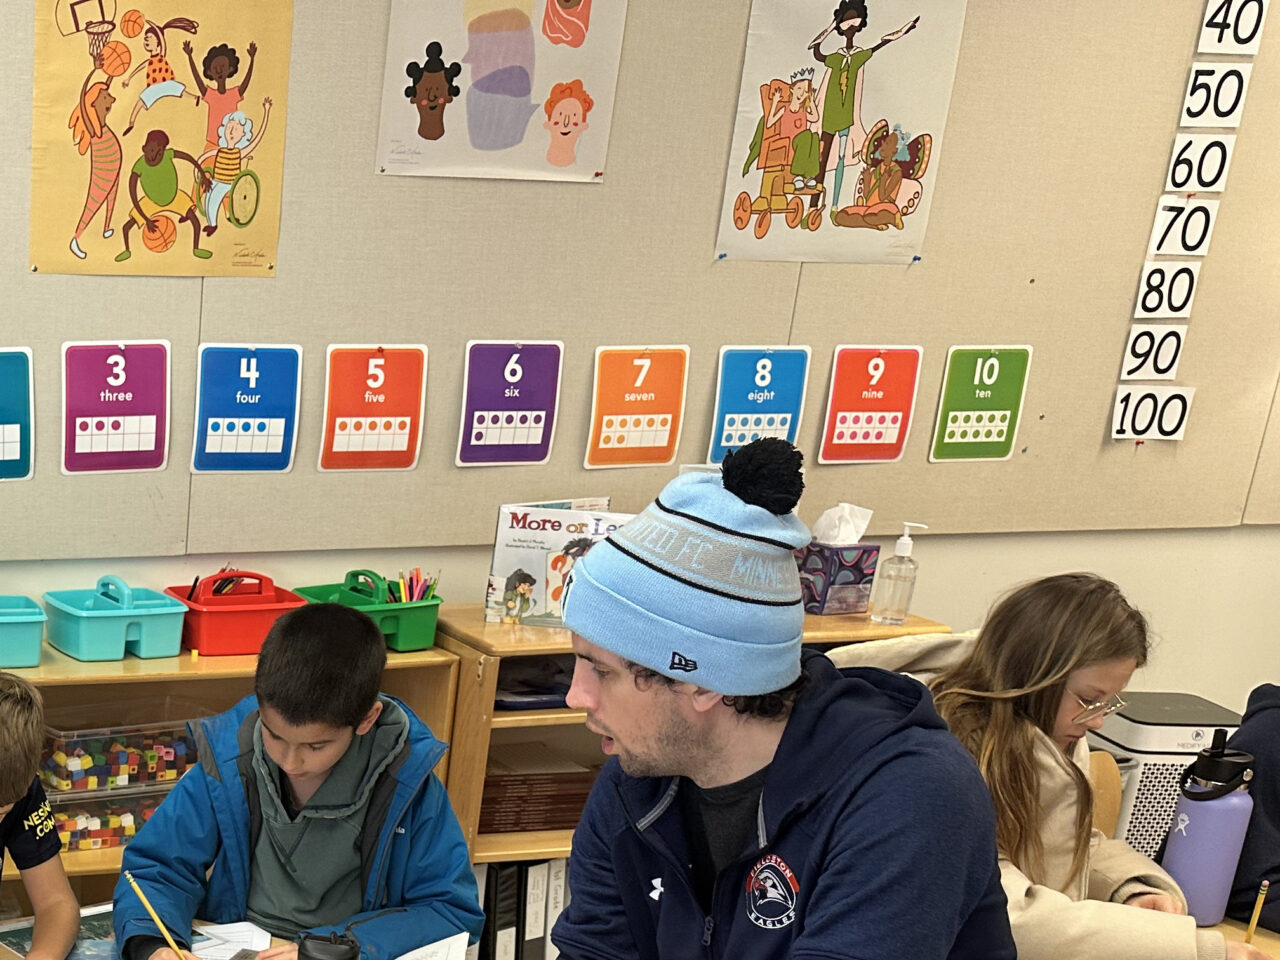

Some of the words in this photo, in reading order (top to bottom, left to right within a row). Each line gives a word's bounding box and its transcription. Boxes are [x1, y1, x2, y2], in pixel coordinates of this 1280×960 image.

[1205, 0, 1264, 44] 40
[1186, 69, 1244, 118] 50
[1171, 140, 1227, 188] 60
[1157, 205, 1211, 251] 70
[1142, 267, 1195, 313] 80
[1127, 330, 1182, 375] 90
[106, 354, 126, 387] 3
[239, 358, 260, 388] 4
[366, 358, 385, 388] 5
[504, 353, 523, 383] 6
[632, 358, 651, 387] 7
[754, 358, 773, 387] 8
[867, 357, 885, 385] 9
[973, 357, 999, 385] 10
[100, 390, 133, 402] three
[236, 391, 261, 403] four
[364, 391, 385, 403] five
[504, 386, 520, 397] six
[625, 392, 655, 401] seven
[747, 390, 775, 402] eight
[862, 389, 884, 399] nine
[975, 389, 991, 398] ten
[1116, 392, 1188, 436] 100
[509, 512, 562, 531] More
[566, 522, 588, 533] or
[592, 518, 624, 536] Le
[674, 537, 713, 569] FC
[750, 854, 794, 878] FIELDSTON
[750, 909, 796, 928] EAGLES
